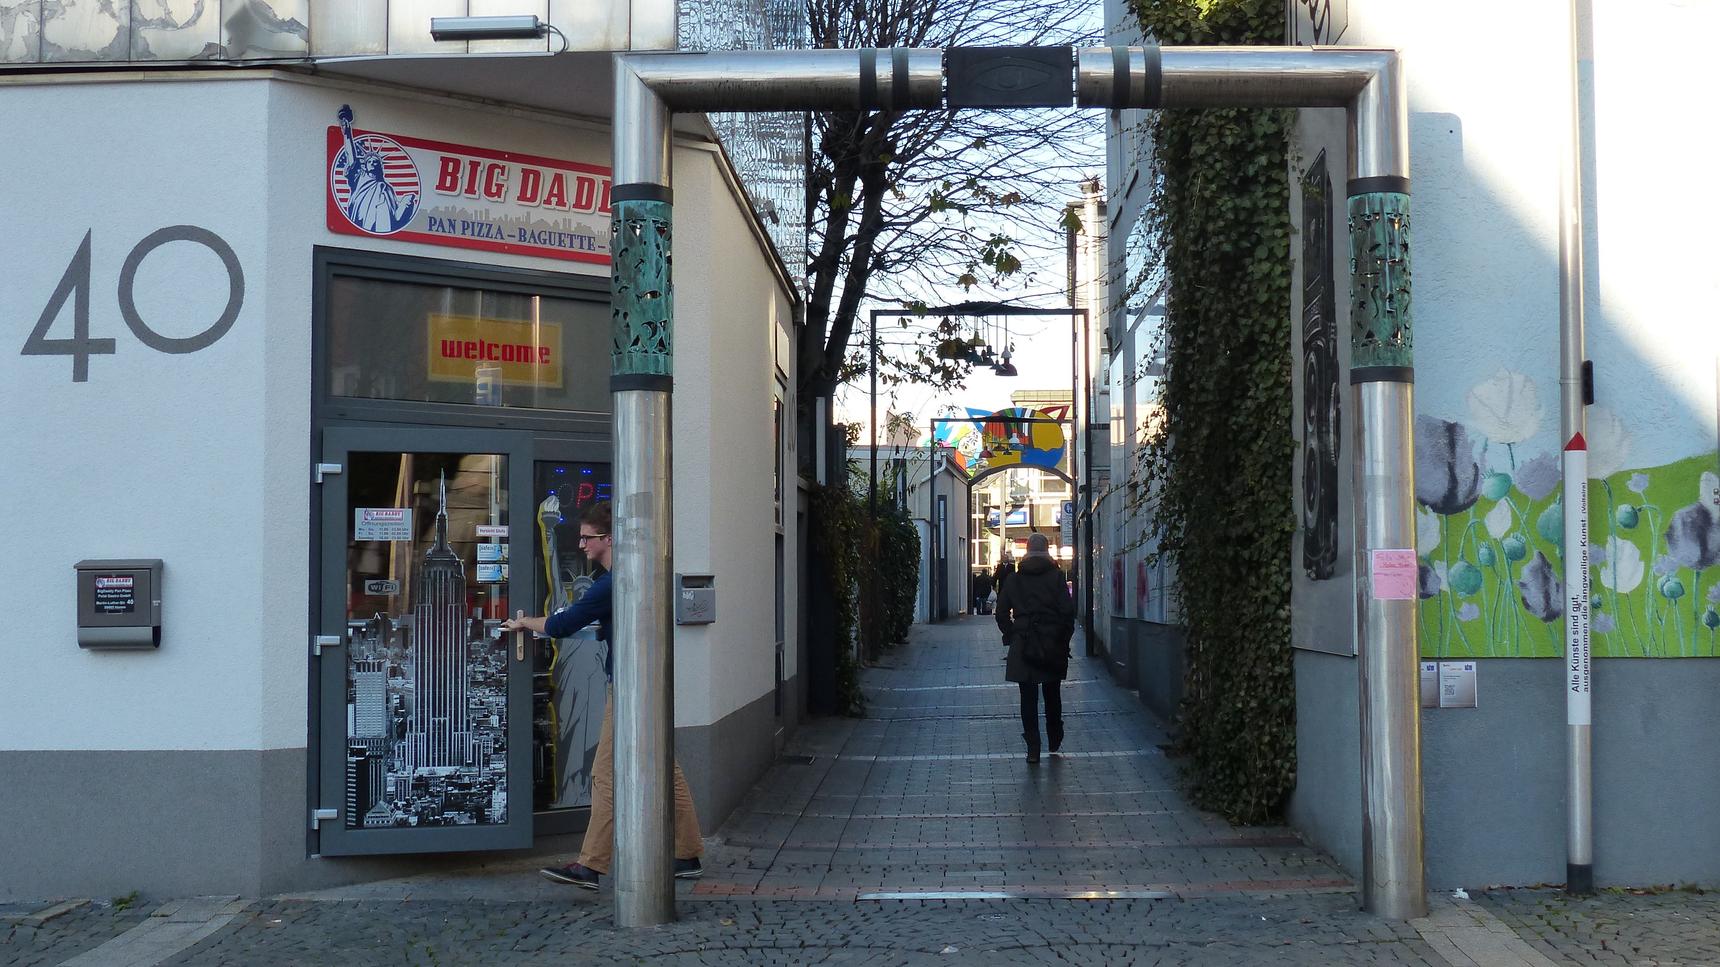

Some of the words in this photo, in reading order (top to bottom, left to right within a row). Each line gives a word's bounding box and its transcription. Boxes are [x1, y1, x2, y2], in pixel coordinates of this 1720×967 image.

[435, 155, 507, 200] BIG
[427, 215, 457, 235] PAN
[461, 219, 506, 241] PIZZA
[518, 227, 597, 252] BAGUETTE
[20, 224, 246, 383] 40
[441, 338, 551, 365] welcome
[1571, 594, 1580, 612] gut,
[1571, 615, 1579, 635] sind
[1571, 674, 1579, 693] Alle
